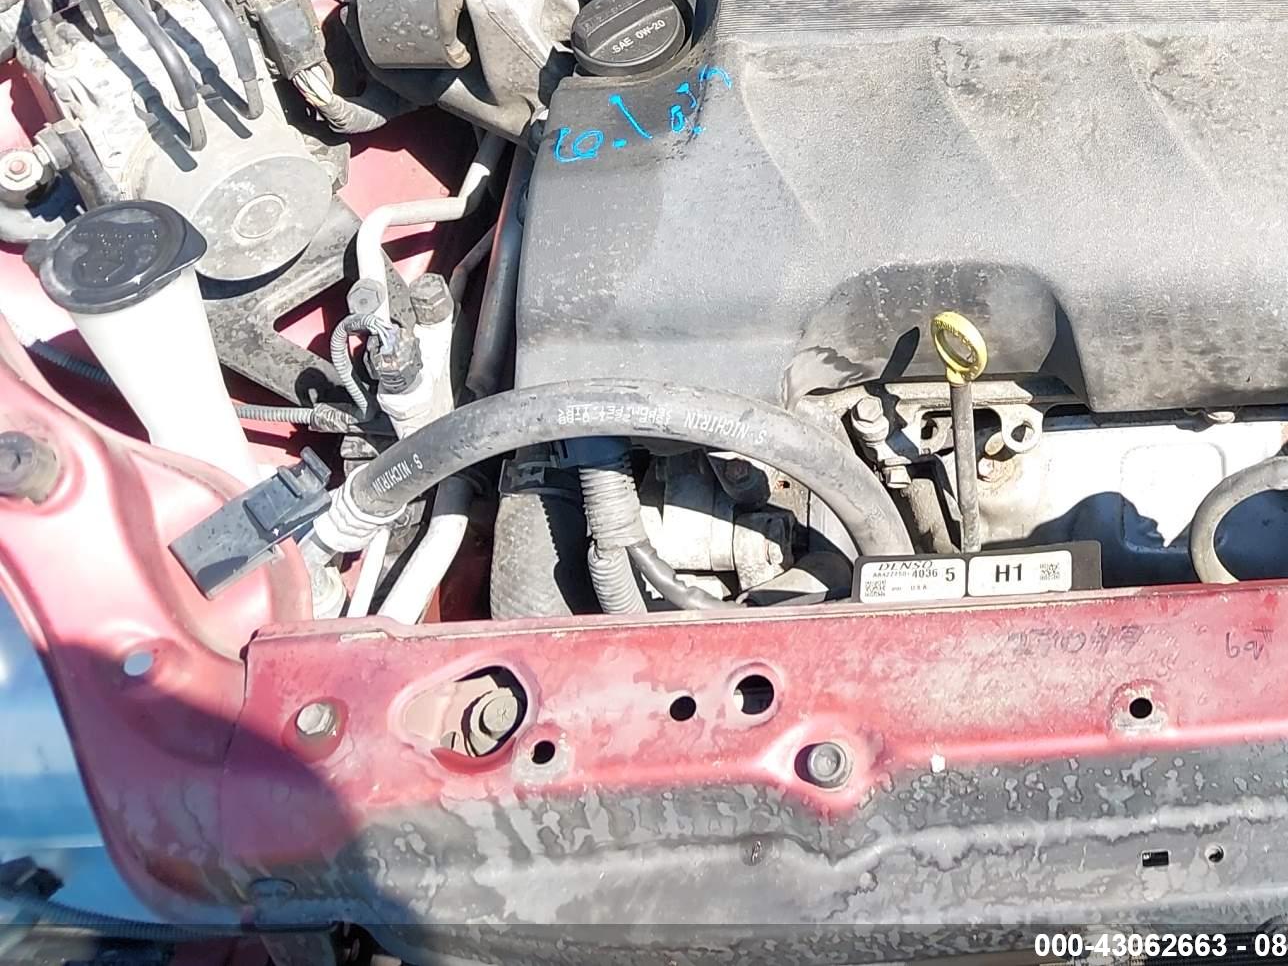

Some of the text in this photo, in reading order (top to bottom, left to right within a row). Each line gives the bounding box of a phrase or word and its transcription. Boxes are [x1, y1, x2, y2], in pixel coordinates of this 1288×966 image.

[612, 19, 666, 54] SAE 0W-20
[945, 567, 956, 582] 5
[994, 563, 1023, 583] H1
